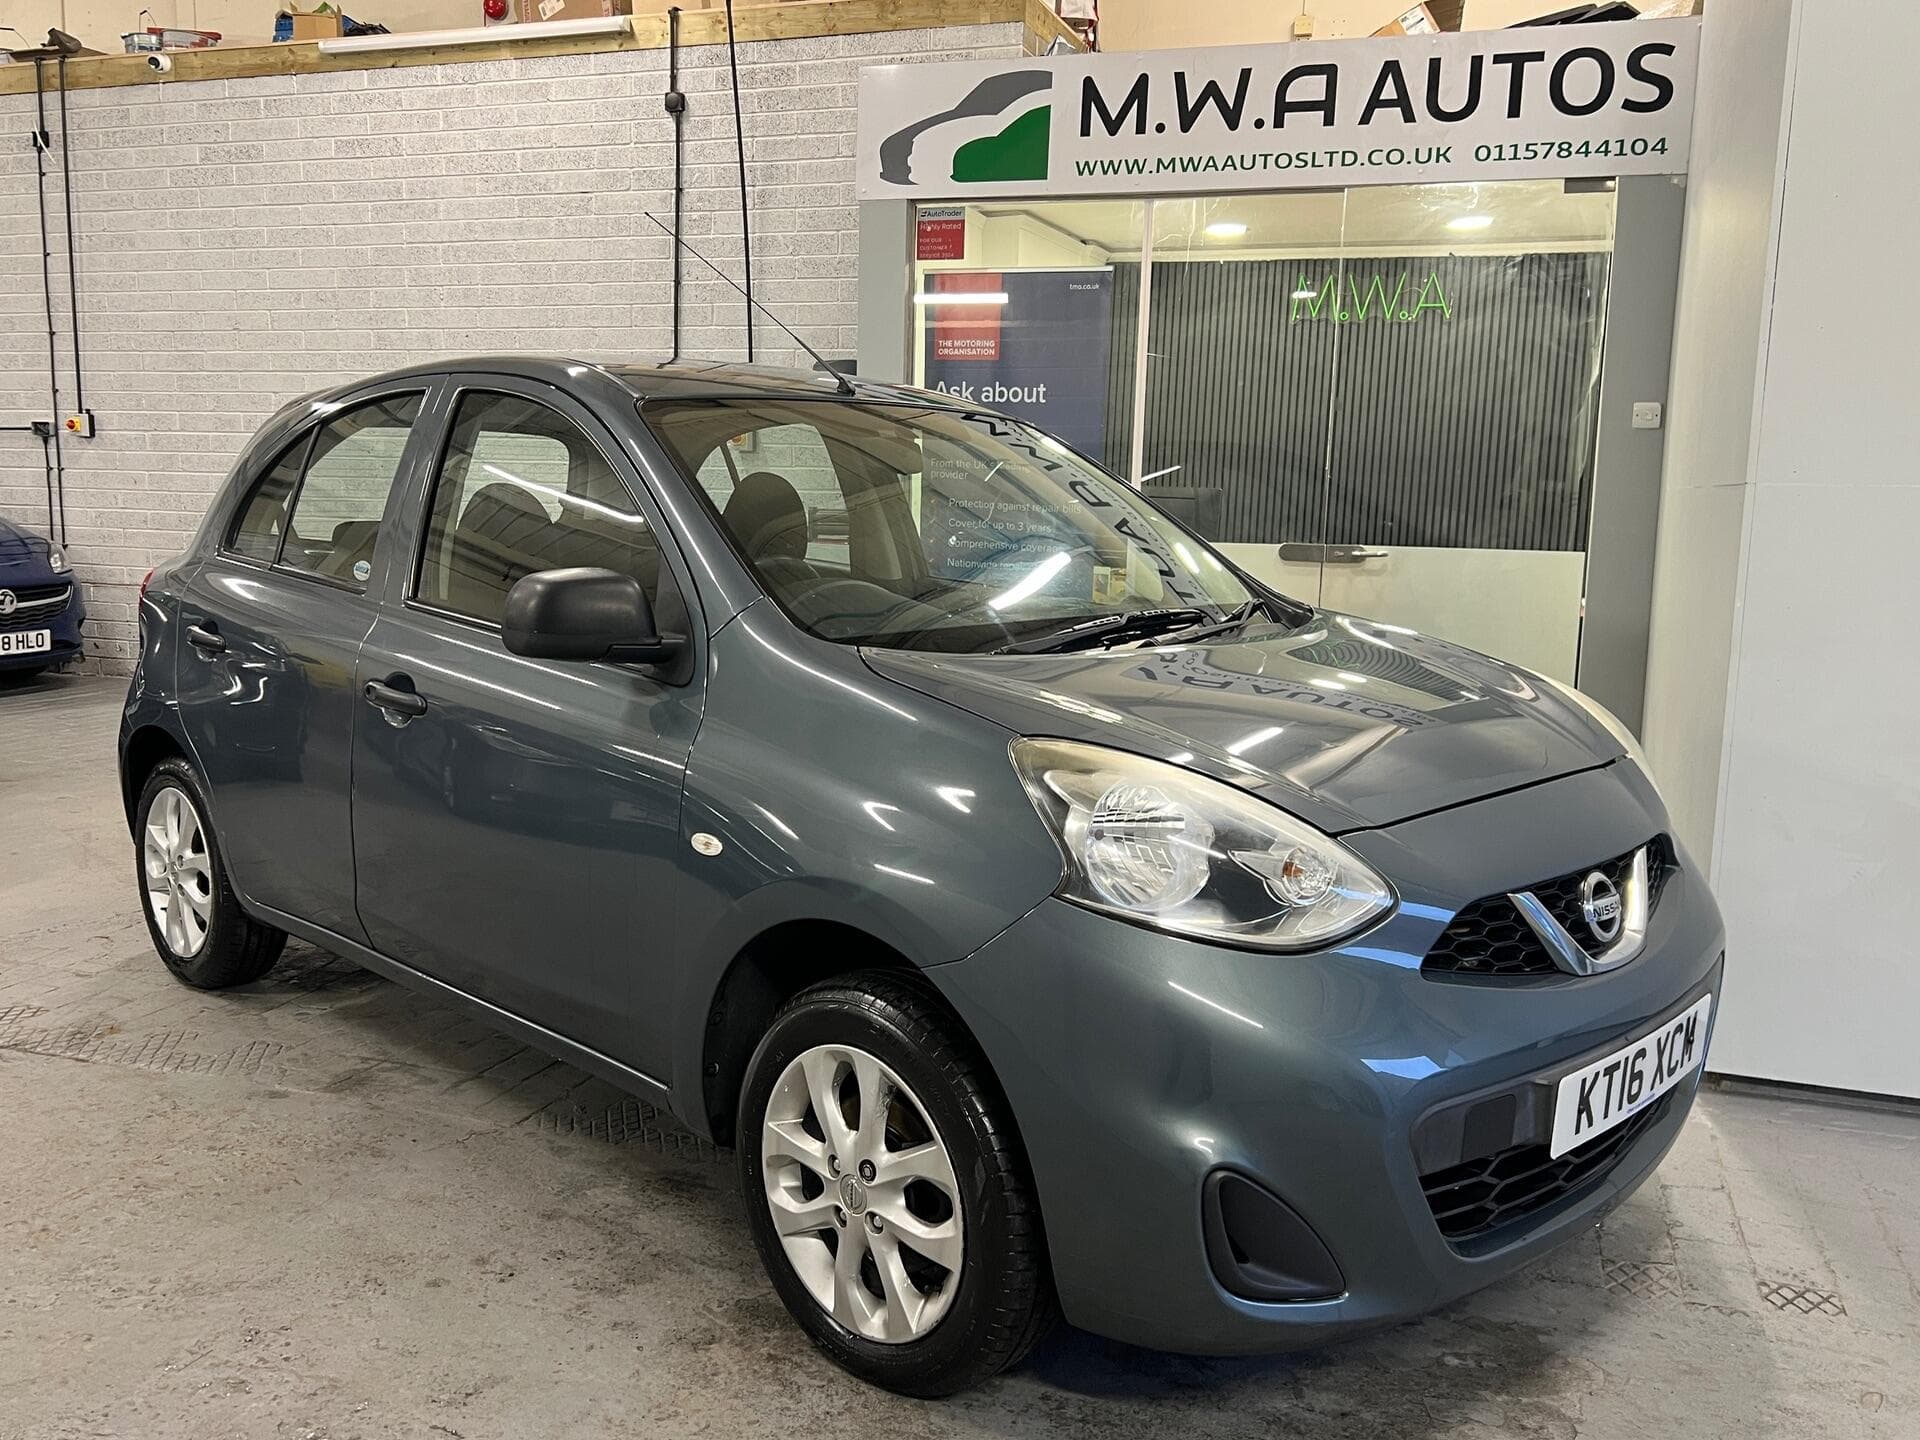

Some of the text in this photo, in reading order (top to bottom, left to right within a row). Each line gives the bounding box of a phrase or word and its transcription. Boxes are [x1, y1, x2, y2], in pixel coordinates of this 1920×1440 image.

[1080, 42, 1676, 137] M.W.A AUTOS
[1075, 137, 1668, 176] WWW.MWAAUTOSLTD.CO.UK 01157844104
[1292, 272, 1450, 322] M.W.A
[938, 340, 953, 348] THE
[938, 348, 995, 356] ORGANISATION
[936, 380, 1047, 403] Ask about
[930, 458, 954, 468] From
[956, 459, 971, 469] the
[930, 469, 968, 481] provider
[949, 497, 994, 509] Protection
[997, 500, 1031, 513] against
[1032, 502, 1059, 514] repair
[949, 519, 976, 529] Cover
[993, 522, 1005, 532] up
[1006, 521, 1016, 530] to
[1018, 521, 1025, 531] 3
[1, 633, 45, 651] 8 HLO
[1574, 1011, 1698, 1136] KT16 XCM
